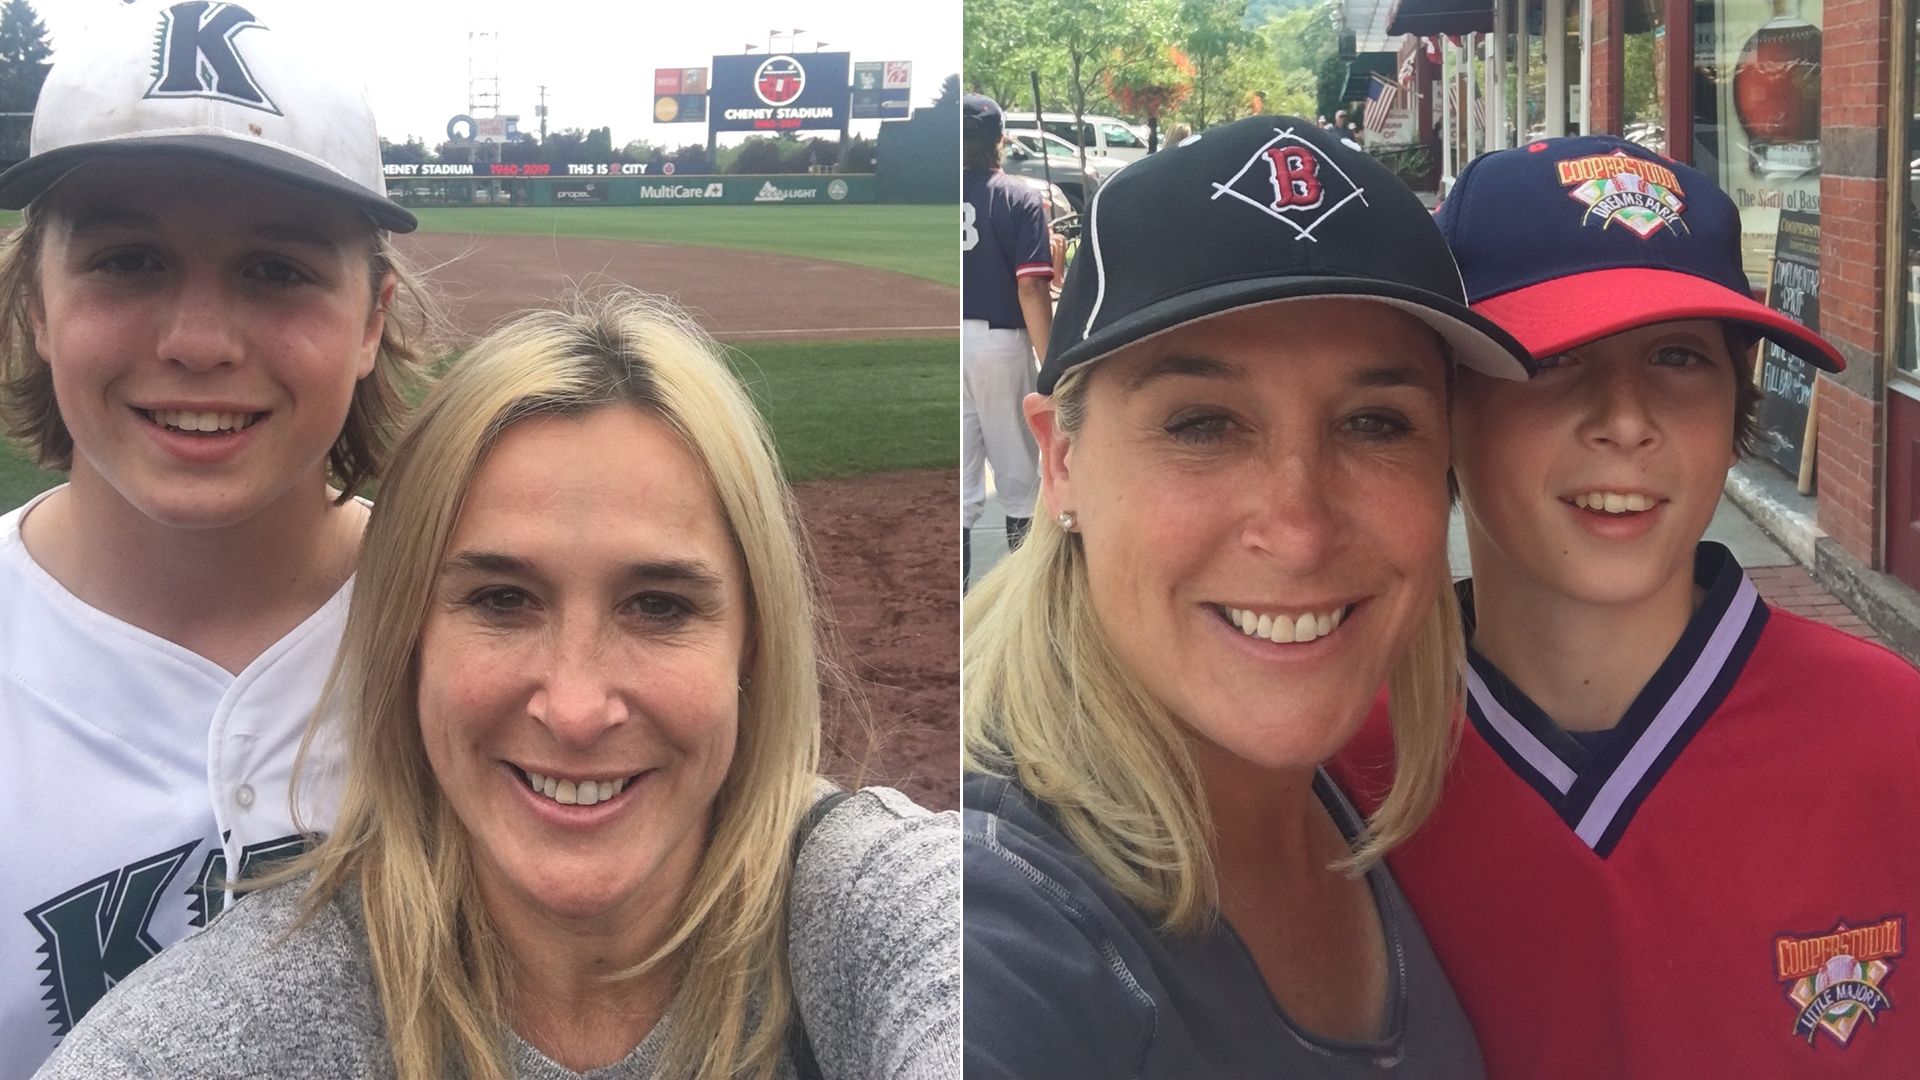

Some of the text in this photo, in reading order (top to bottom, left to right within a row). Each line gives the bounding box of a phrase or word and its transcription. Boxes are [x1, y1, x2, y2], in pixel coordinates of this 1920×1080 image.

[143, 1, 284, 116] K
[724, 107, 833, 120] CHENEY STADIUM
[421, 164, 474, 175] STADIUM
[568, 164, 594, 175] THIS
[596, 164, 608, 175] IS
[622, 164, 648, 175] CITY
[1262, 145, 1324, 212] B
[1558, 156, 1686, 197] COOPERSTOWN
[640, 185, 703, 199] MultiCare
[789, 188, 817, 198] LIGHT
[1592, 192, 1680, 223] DREAMS PARK
[1737, 188, 1756, 208] The
[1758, 188, 1784, 210] Spirit
[1787, 190, 1797, 209] of
[1764, 362, 1779, 393] FULL
[1779, 369, 1793, 399] BAR
[1779, 920, 1899, 977] COOPERSTOWN
[1801, 984, 1881, 1029] LITTLE MAJORS
